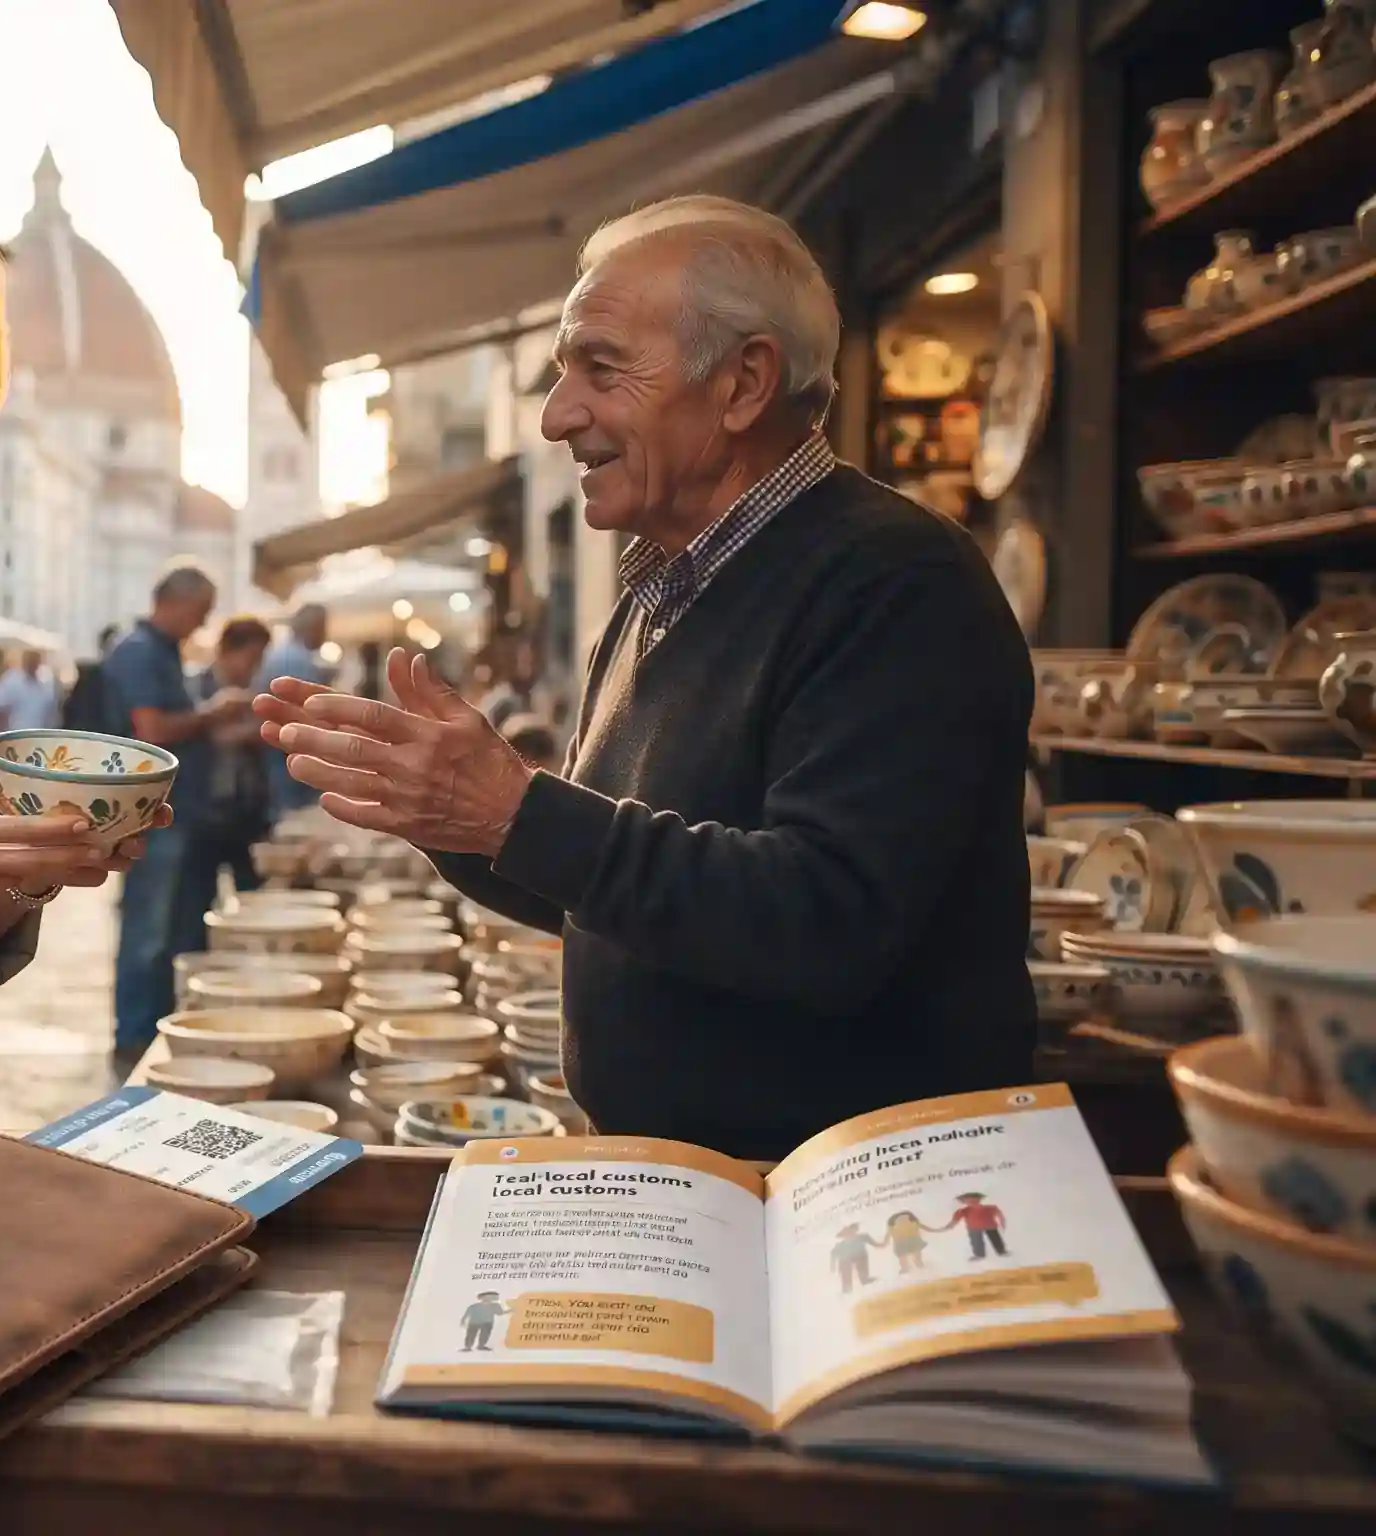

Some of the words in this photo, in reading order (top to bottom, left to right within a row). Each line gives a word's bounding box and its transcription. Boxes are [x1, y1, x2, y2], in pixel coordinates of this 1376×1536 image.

[602, 1172, 693, 1189] customs
[492, 1183, 542, 1198] local
[550, 1185, 638, 1197] customs
